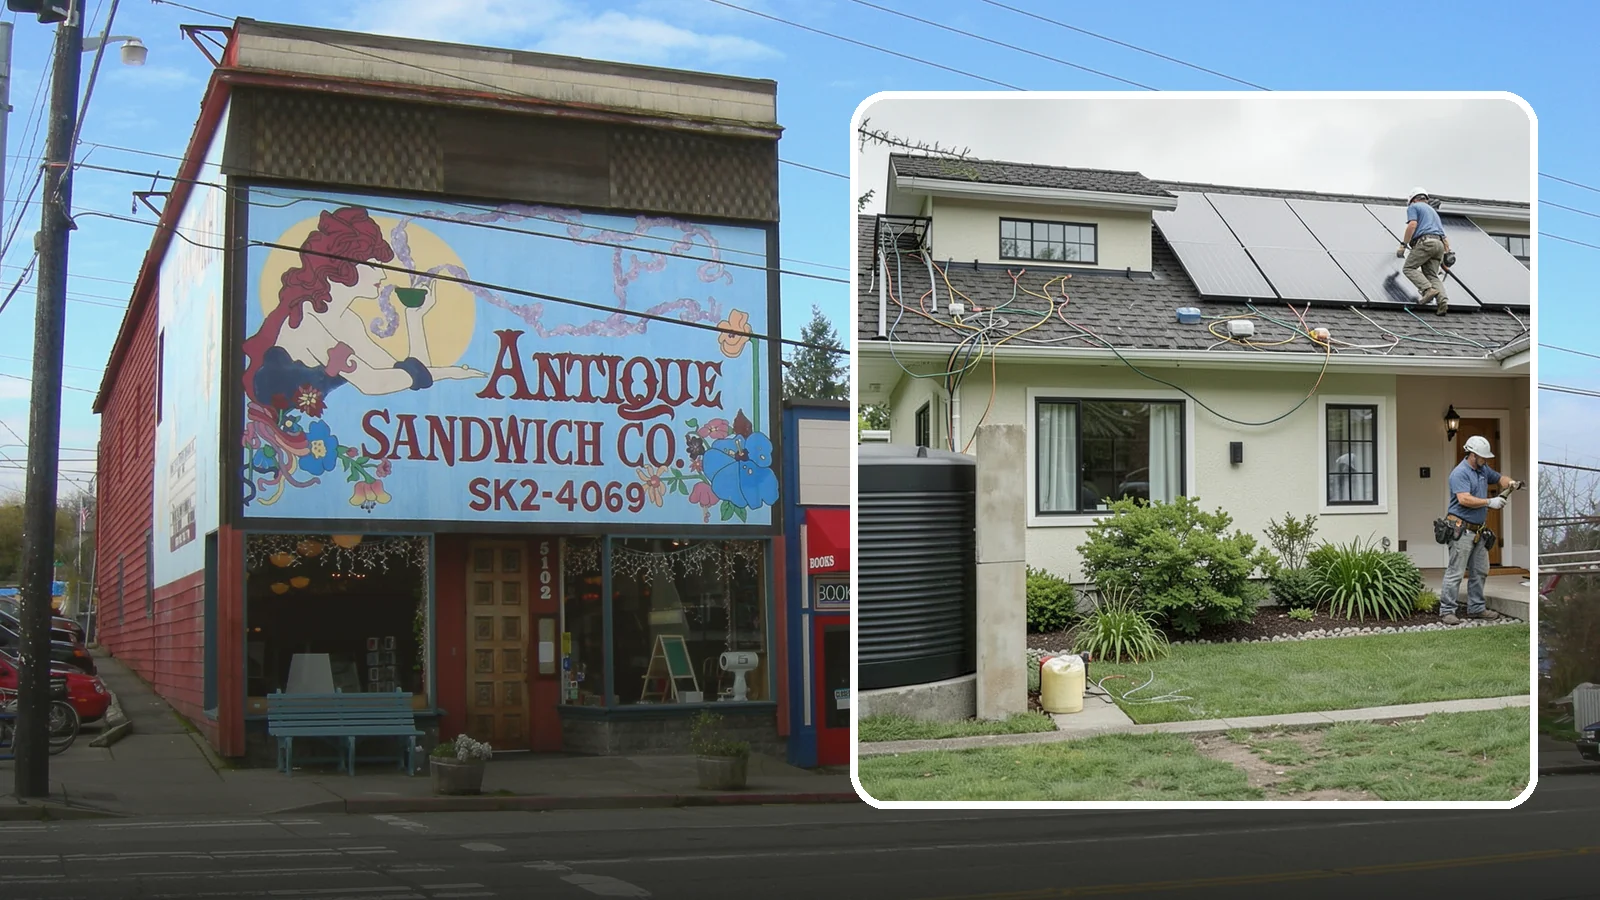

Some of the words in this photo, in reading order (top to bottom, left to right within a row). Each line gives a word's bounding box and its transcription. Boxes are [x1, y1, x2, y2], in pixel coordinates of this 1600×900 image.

[475, 328, 724, 421] ANTIQUE
[361, 408, 605, 468] SANDWICH
[617, 421, 685, 469] CO.
[467, 477, 645, 513] SK2-4069
[538, 541, 551, 600] 5102
[809, 555, 835, 569] BOOKS
